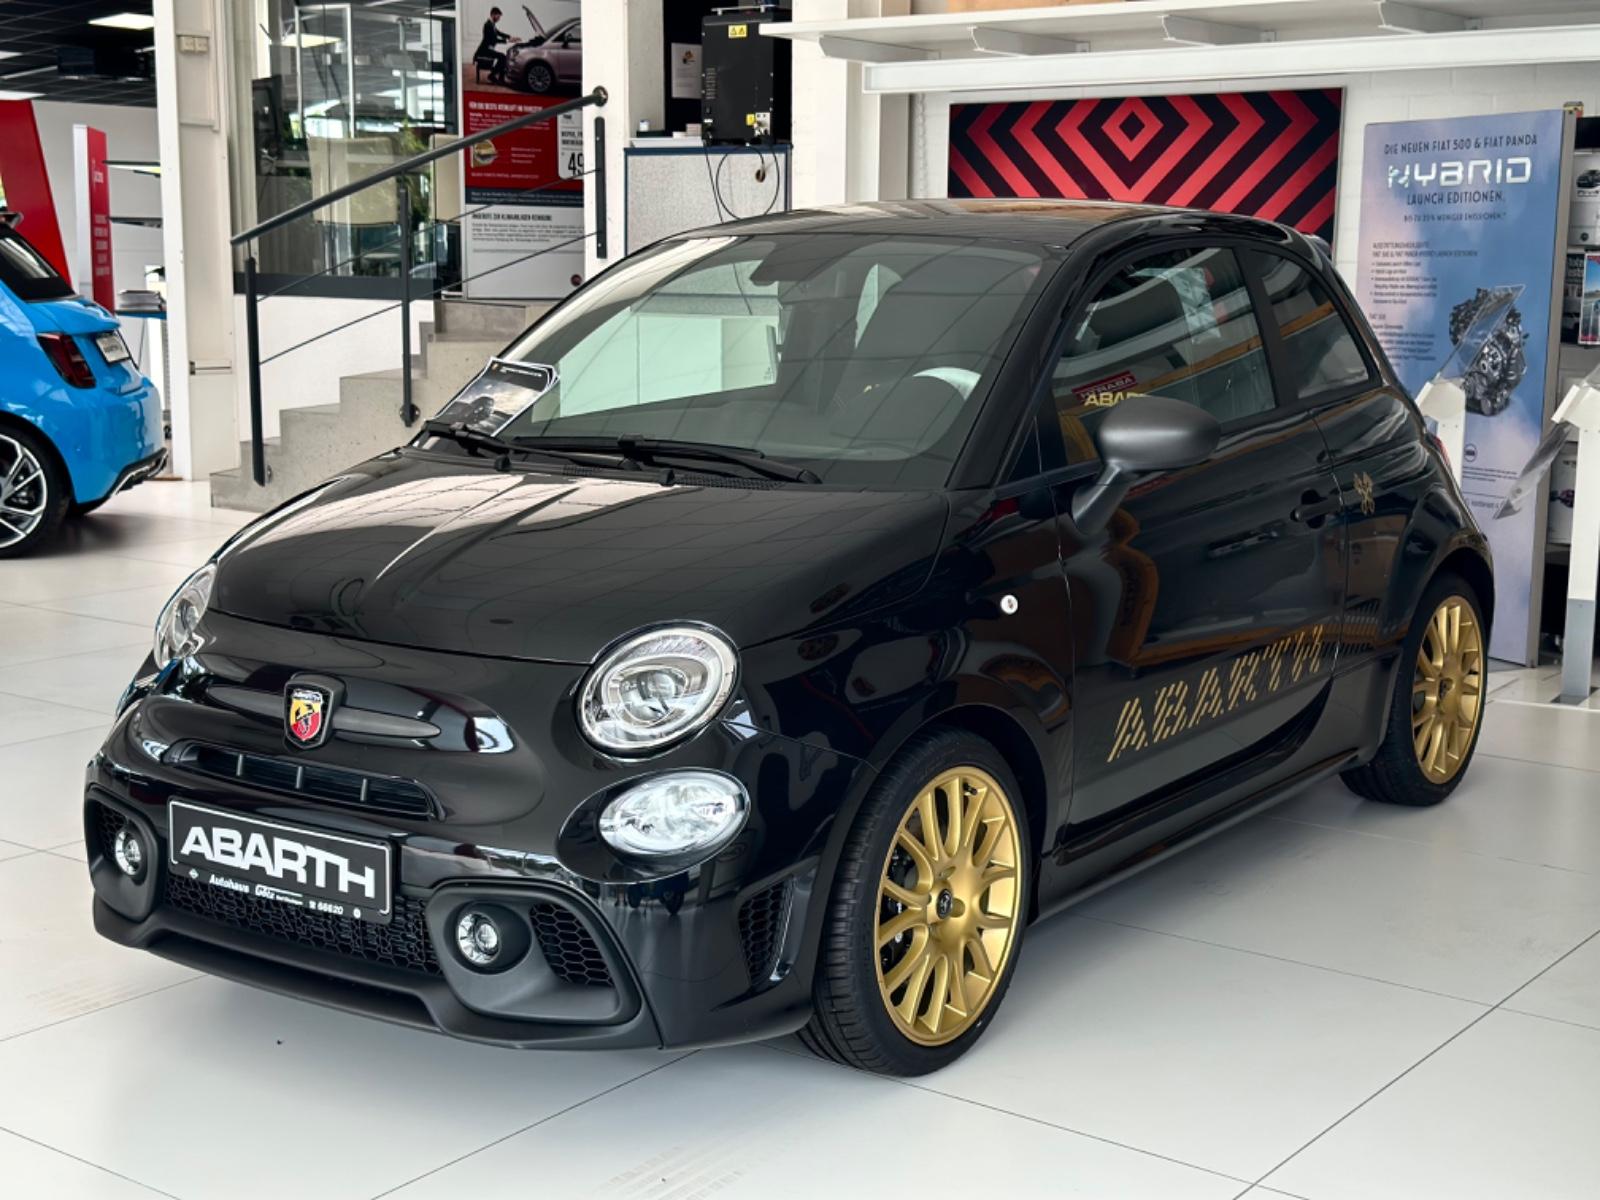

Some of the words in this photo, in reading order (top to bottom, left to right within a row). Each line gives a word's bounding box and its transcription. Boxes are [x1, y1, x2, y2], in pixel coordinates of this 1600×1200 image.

[1384, 144, 1398, 155] DIE
[1401, 141, 1430, 154] NEUEN
[1432, 140, 1451, 152] FIAT
[1453, 139, 1472, 151] 500
[1474, 138, 1481, 149] &
[1483, 137, 1504, 149] FIAT
[1506, 134, 1538, 147] PANDA
[1388, 156, 1532, 188] HYBRID
[1407, 192, 1444, 205] LAUNCH
[1106, 624, 1324, 763] ABARTH
[180, 826, 376, 899] ABARTH
[209, 874, 250, 894] Autohaus
